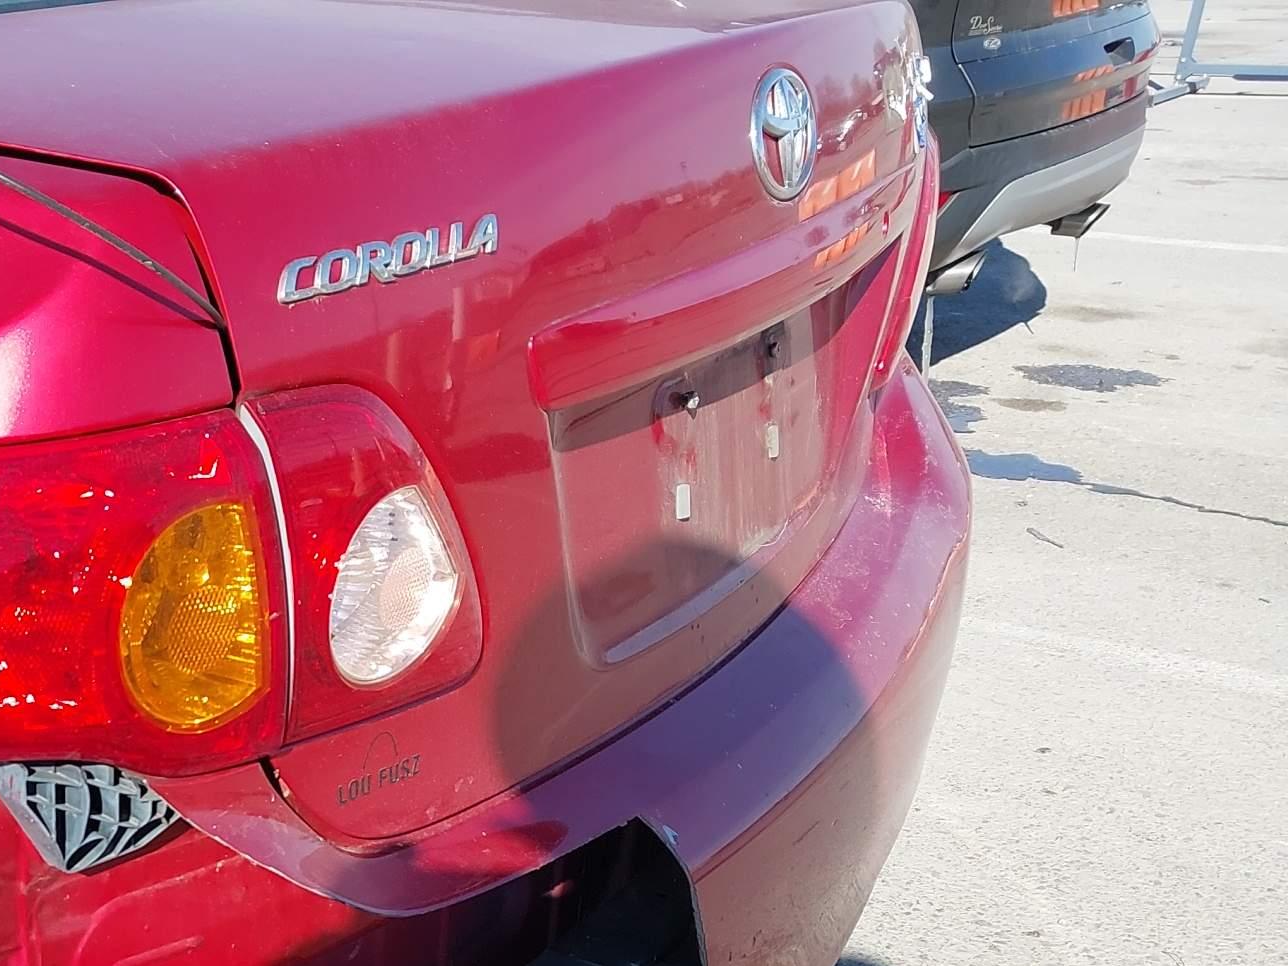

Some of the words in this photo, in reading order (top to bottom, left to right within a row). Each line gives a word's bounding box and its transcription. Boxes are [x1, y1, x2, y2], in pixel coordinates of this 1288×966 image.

[277, 213, 499, 304] COROLLA
[336, 773, 373, 806] LOU
[377, 752, 422, 789] FUSZ
